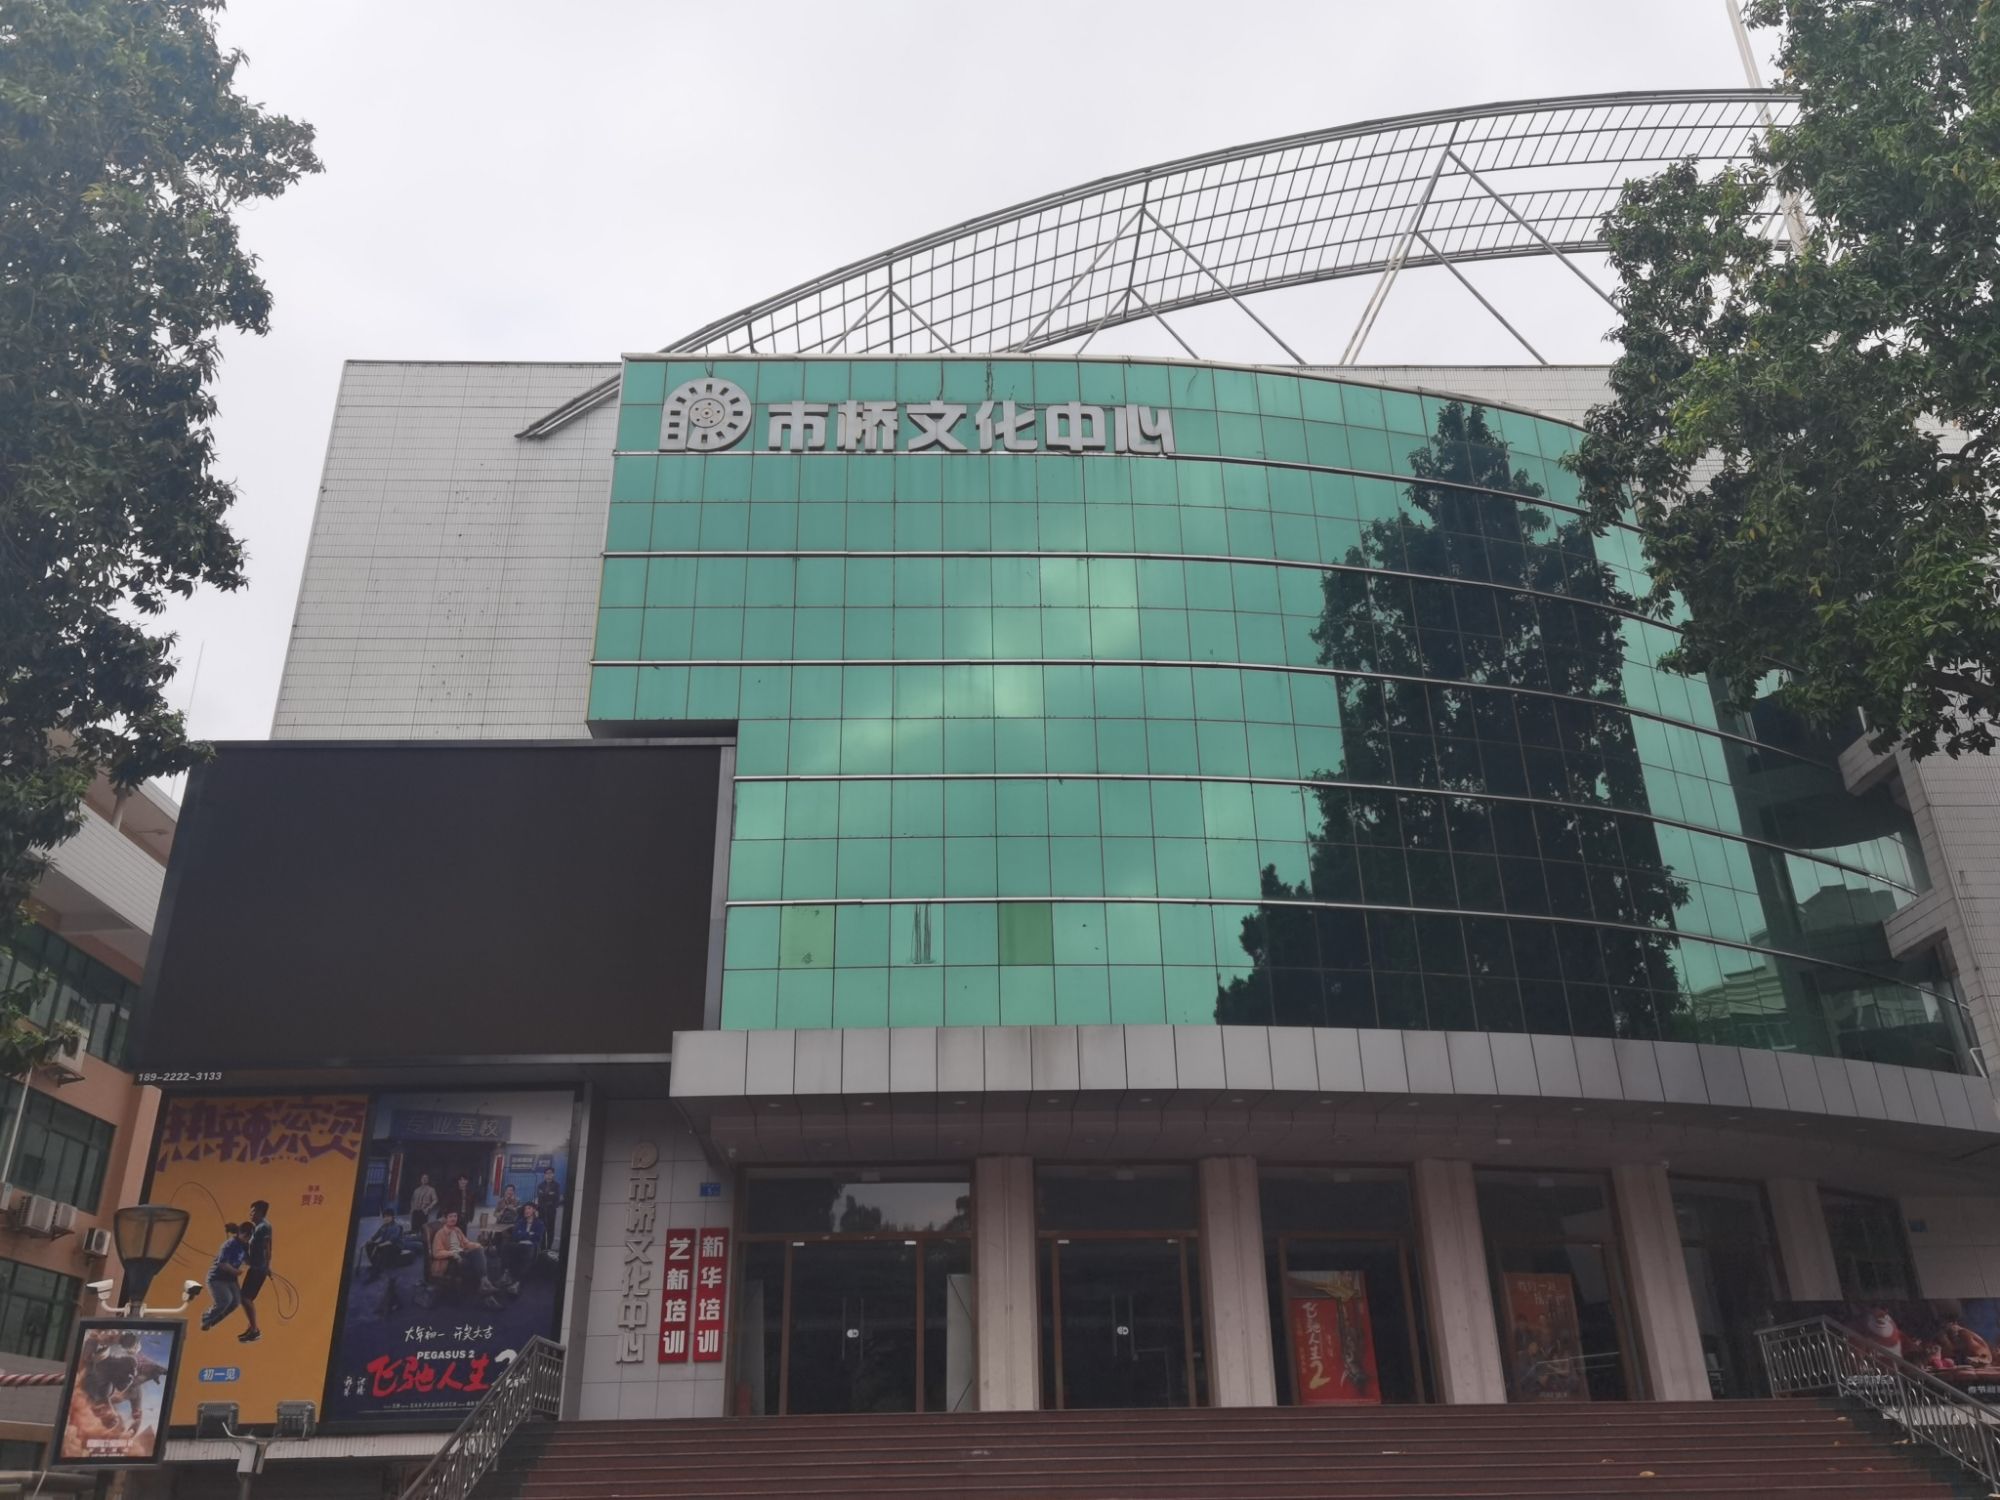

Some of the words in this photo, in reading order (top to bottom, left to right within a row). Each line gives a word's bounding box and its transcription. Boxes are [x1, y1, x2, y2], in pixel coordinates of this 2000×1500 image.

[767, 400, 1175, 454] 市桥文化中心
[138, 1072, 222, 1082] 189-2222-3133
[407, 1116, 498, 1137] 专业驾校
[616, 1175, 658, 1363] 市桥文化中心
[663, 1237, 691, 1354] 艺新培训
[697, 1236, 724, 1353] 新华培训
[416, 1350, 466, 1360] PEGASUS
[468, 1350, 475, 1359] 2
